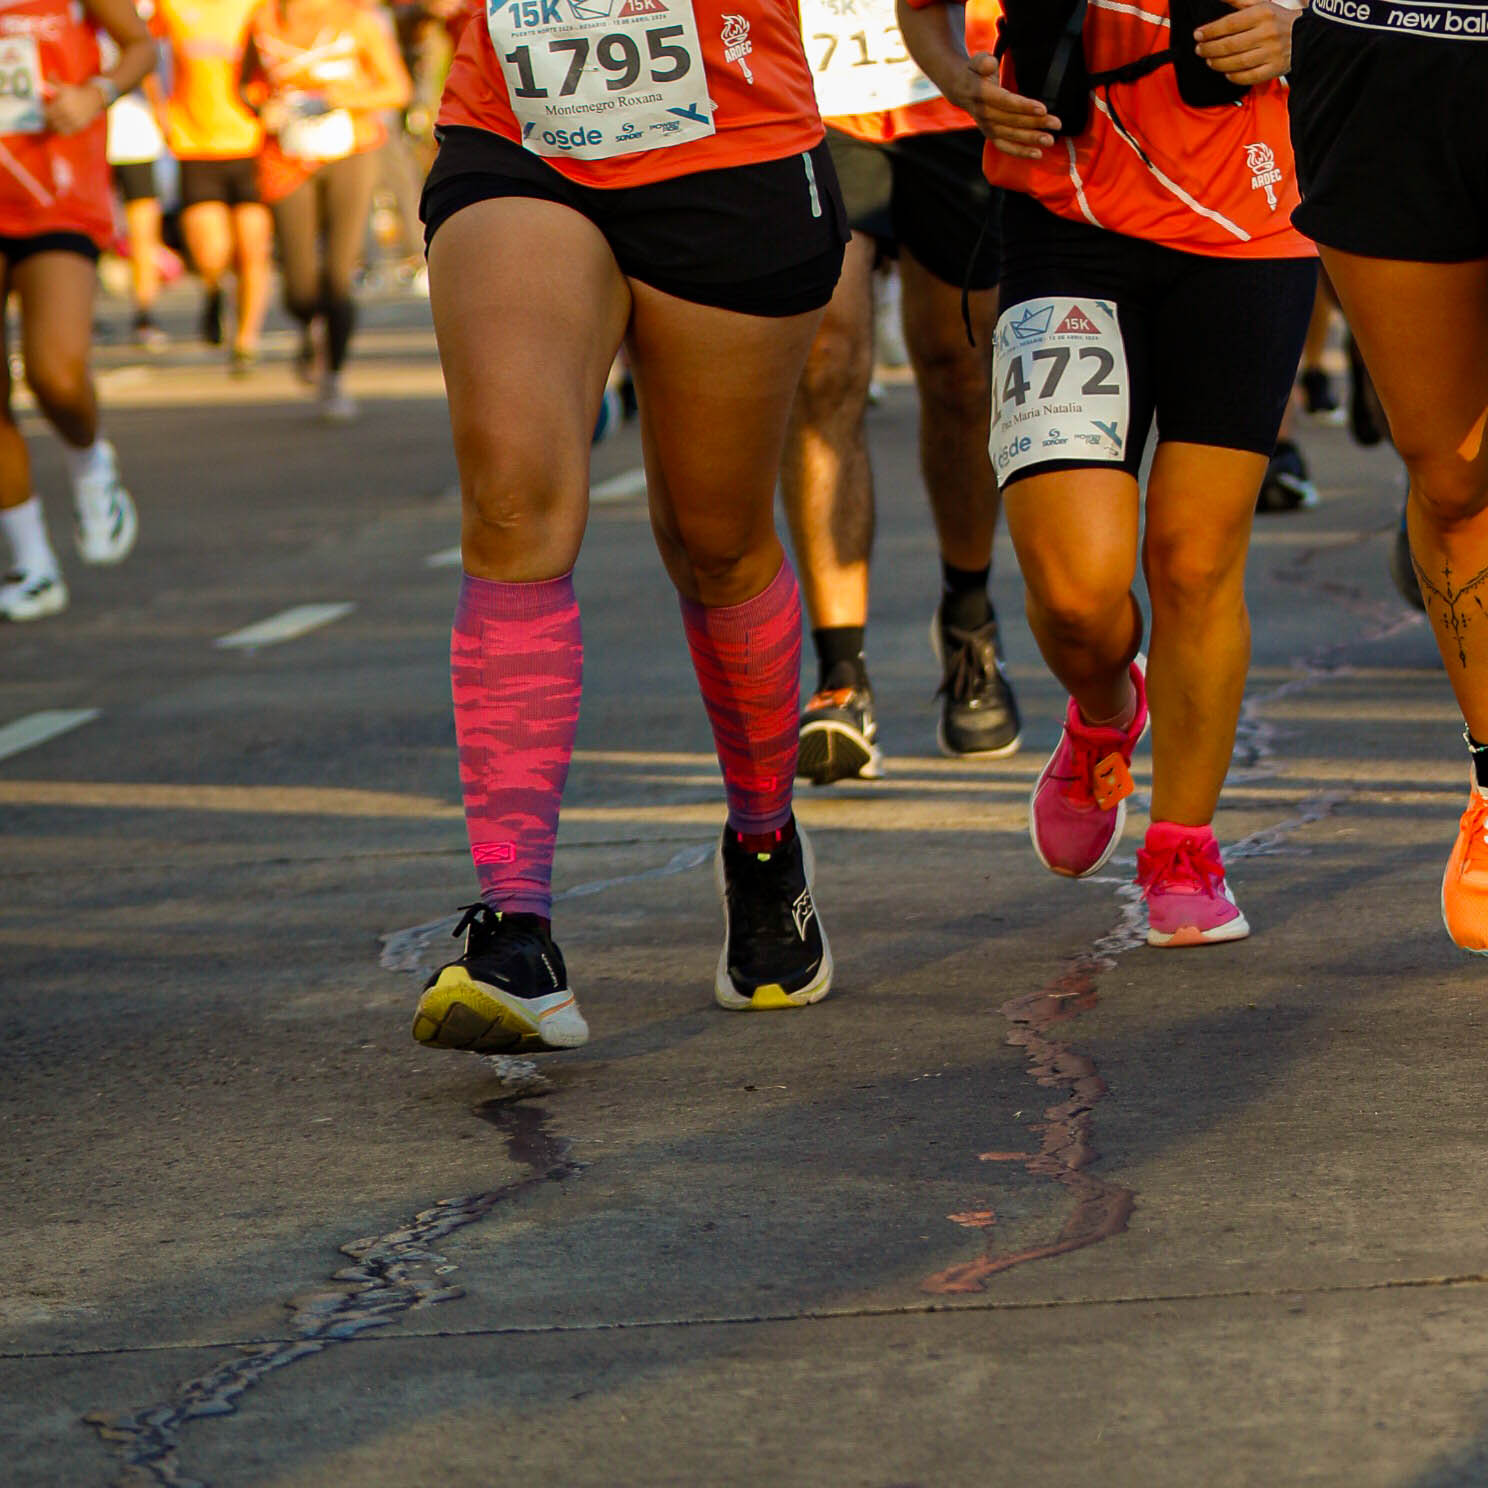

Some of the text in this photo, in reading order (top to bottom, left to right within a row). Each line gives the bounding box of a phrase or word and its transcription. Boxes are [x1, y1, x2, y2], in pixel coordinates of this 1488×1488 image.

[1388, 8, 1441, 29] new
[505, 25, 691, 98] 1795
[724, 40, 752, 63] ARDEC
[544, 93, 663, 117] Montenegro Roxana
[542, 127, 603, 150] osde
[1251, 168, 1282, 190] ARDEC
[1064, 318, 1090, 330] 15K
[993, 346, 1120, 426] 472
[1013, 403, 1082, 424] Maria Natalia
